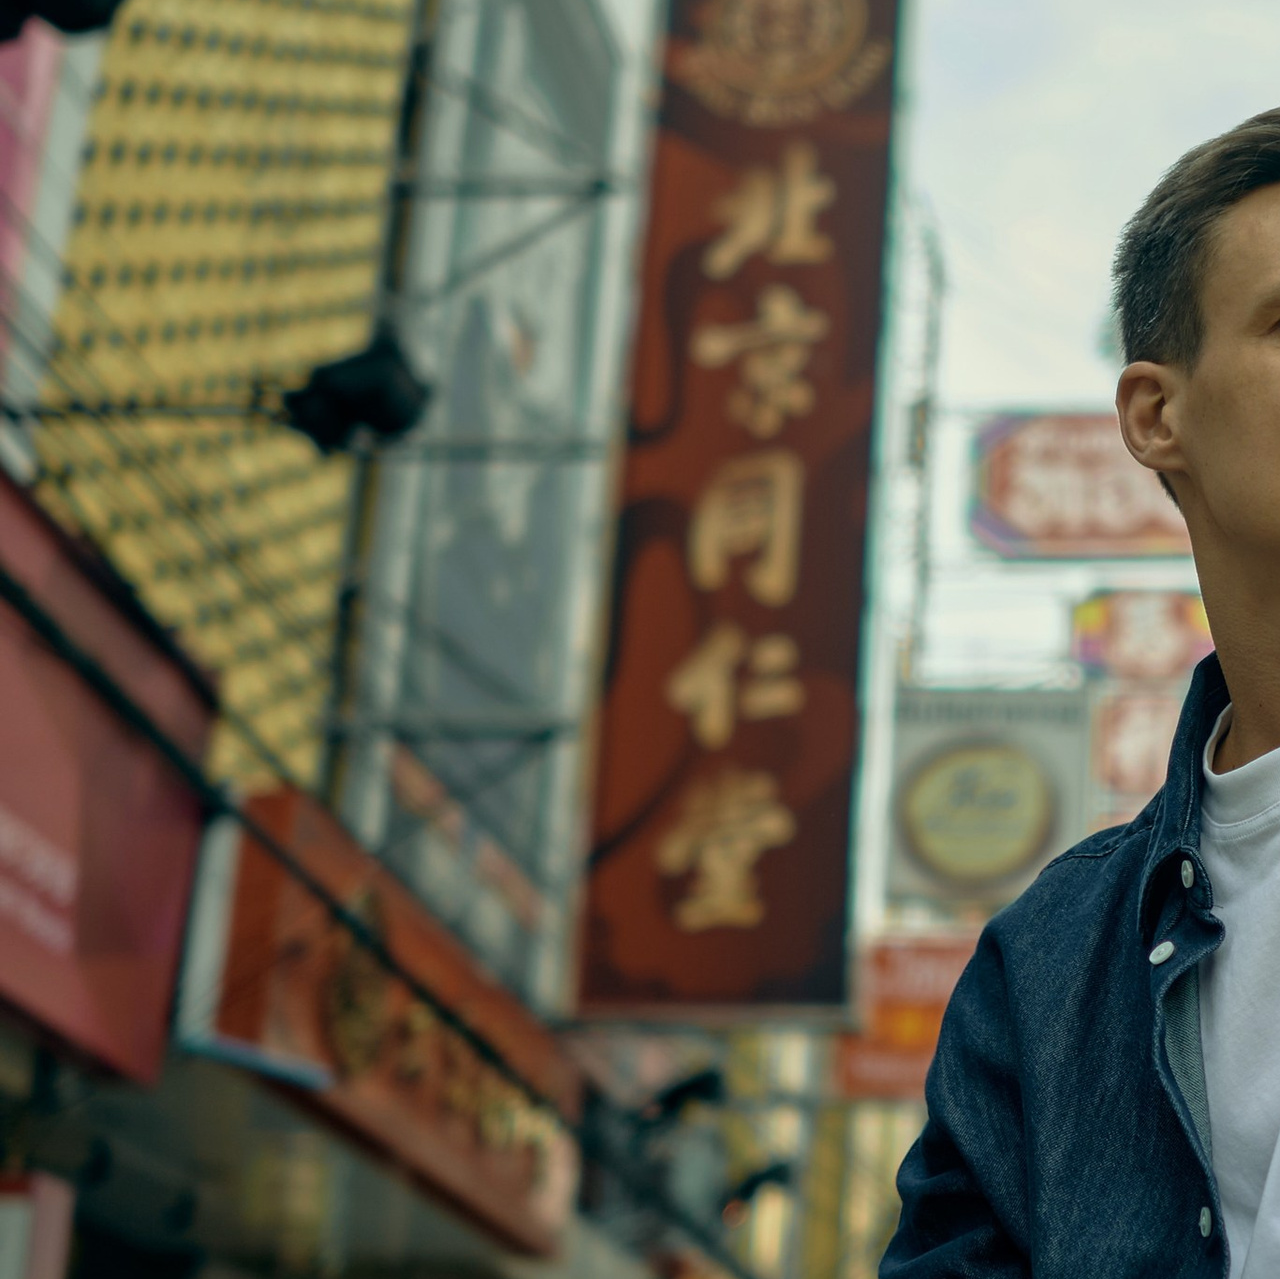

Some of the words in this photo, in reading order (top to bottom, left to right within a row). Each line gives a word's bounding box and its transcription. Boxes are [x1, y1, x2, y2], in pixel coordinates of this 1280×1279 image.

[656, 141, 835, 930] 北京同仁堂
